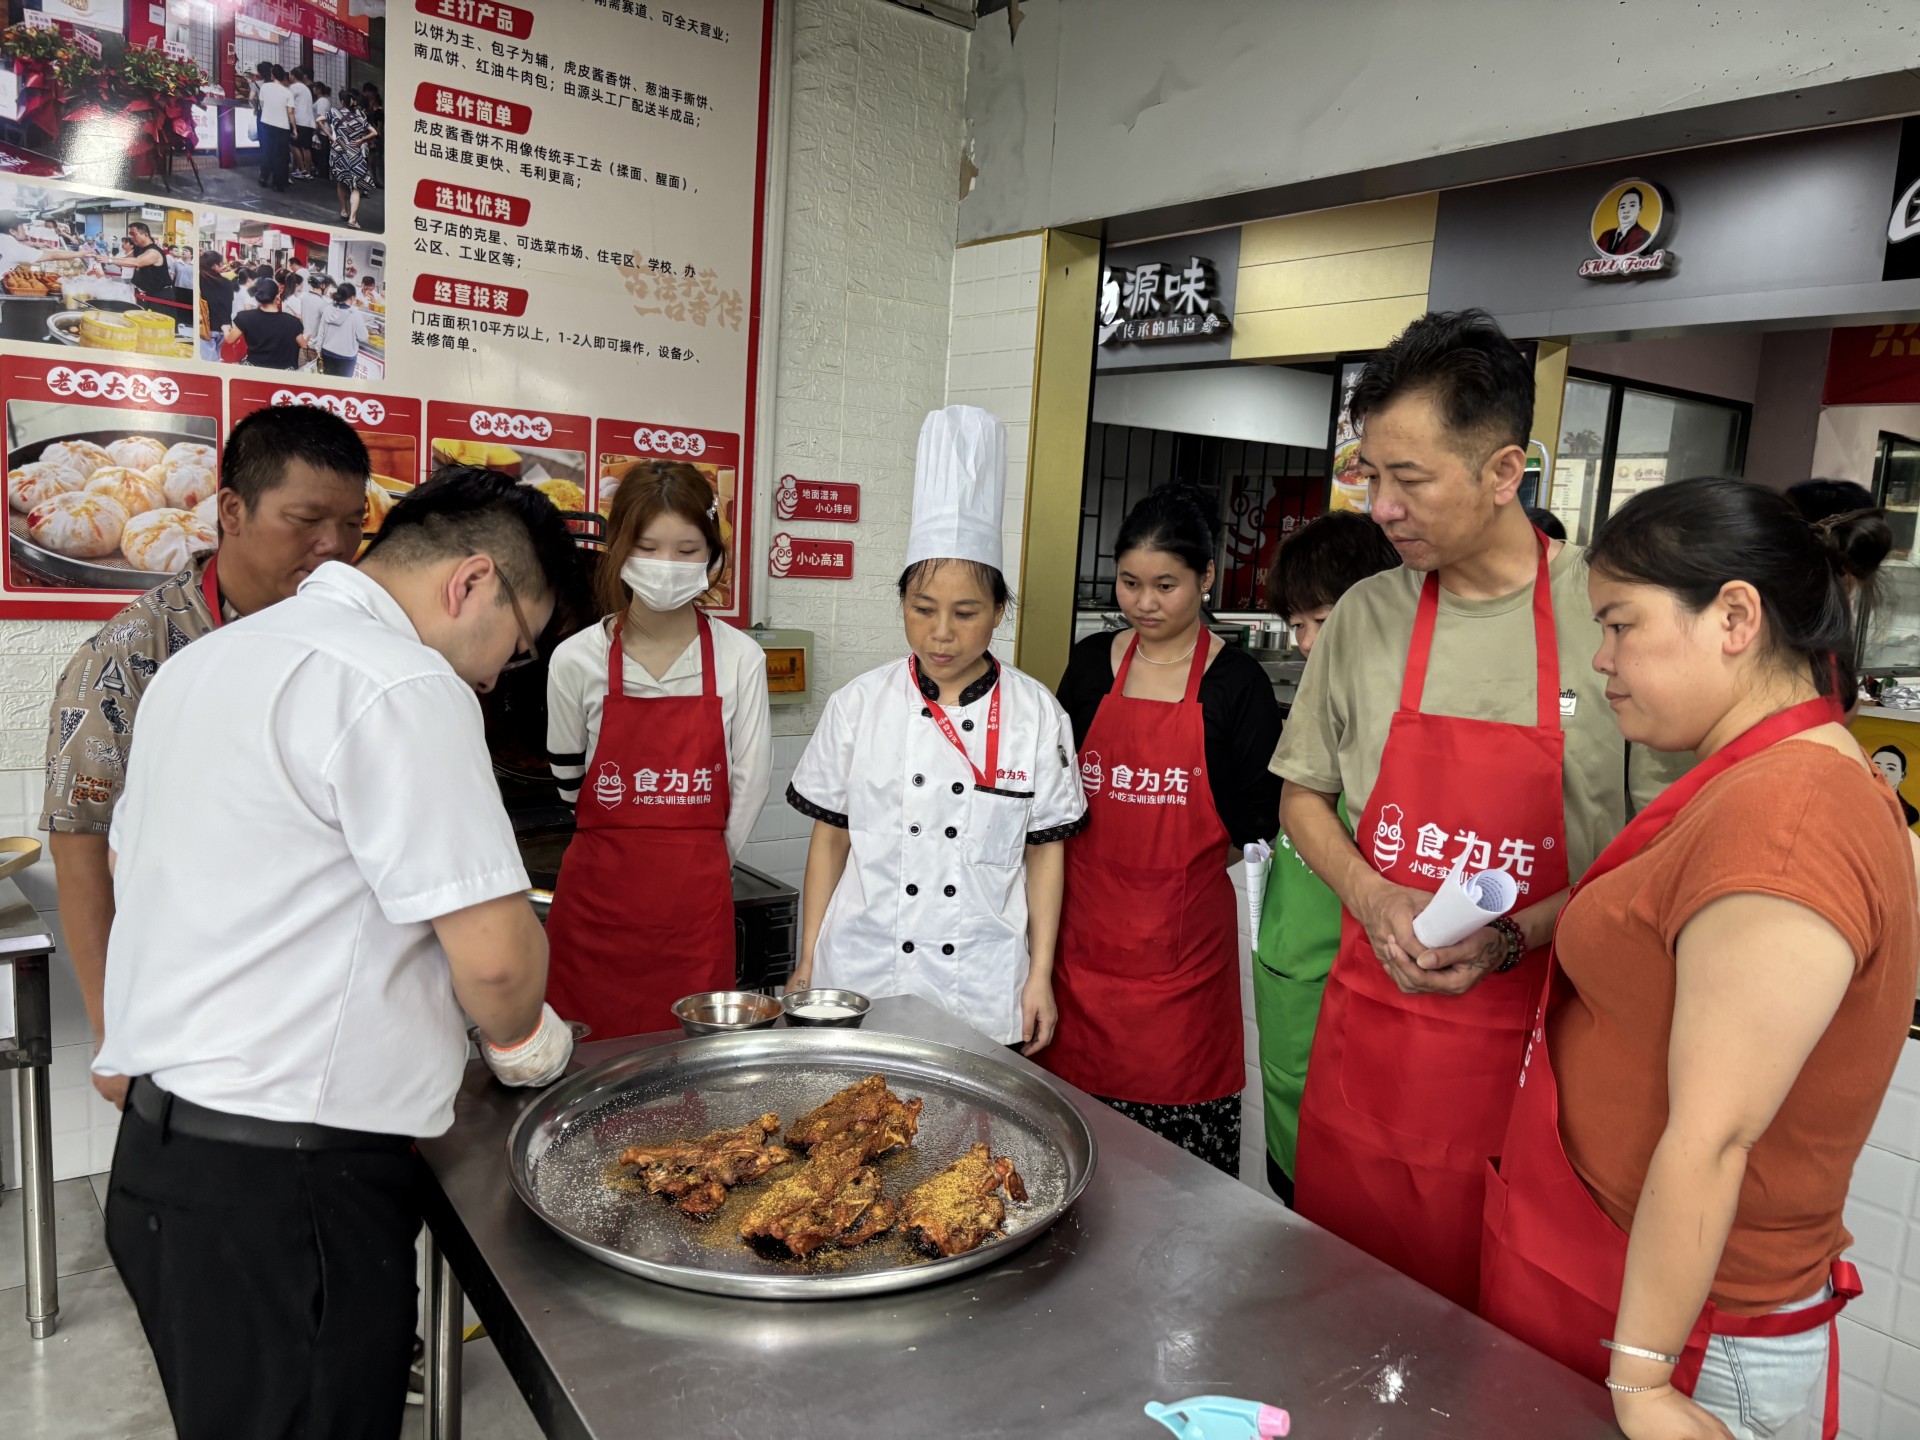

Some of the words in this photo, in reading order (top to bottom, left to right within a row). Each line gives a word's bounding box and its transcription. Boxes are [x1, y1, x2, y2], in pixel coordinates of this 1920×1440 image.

[436, 89, 512, 127] 操作简单
[435, 186, 511, 221] 选址优势
[1622, 250, 1664, 273] Food
[434, 280, 509, 312] 经营投资
[1122, 256, 1209, 319] 源味
[1122, 317, 1196, 340] 传承的味道
[411, 330, 477, 353] 装修简单。
[50, 370, 177, 401] 老面大包子
[475, 415, 550, 438] 油炸小吃
[638, 429, 700, 451] 成品配送
[802, 489, 839, 501] 地面湿滑
[815, 503, 852, 514] 小心摔倒
[796, 552, 844, 567] 小心高温
[633, 768, 712, 793] 食为先
[996, 769, 1027, 781] 食为先
[1111, 764, 1189, 793] 食为先
[632, 794, 711, 806] 小吃实训连锁机构
[1108, 789, 1187, 806] 小吃实训连锁机构
[1416, 822, 1535, 877] 食为先
